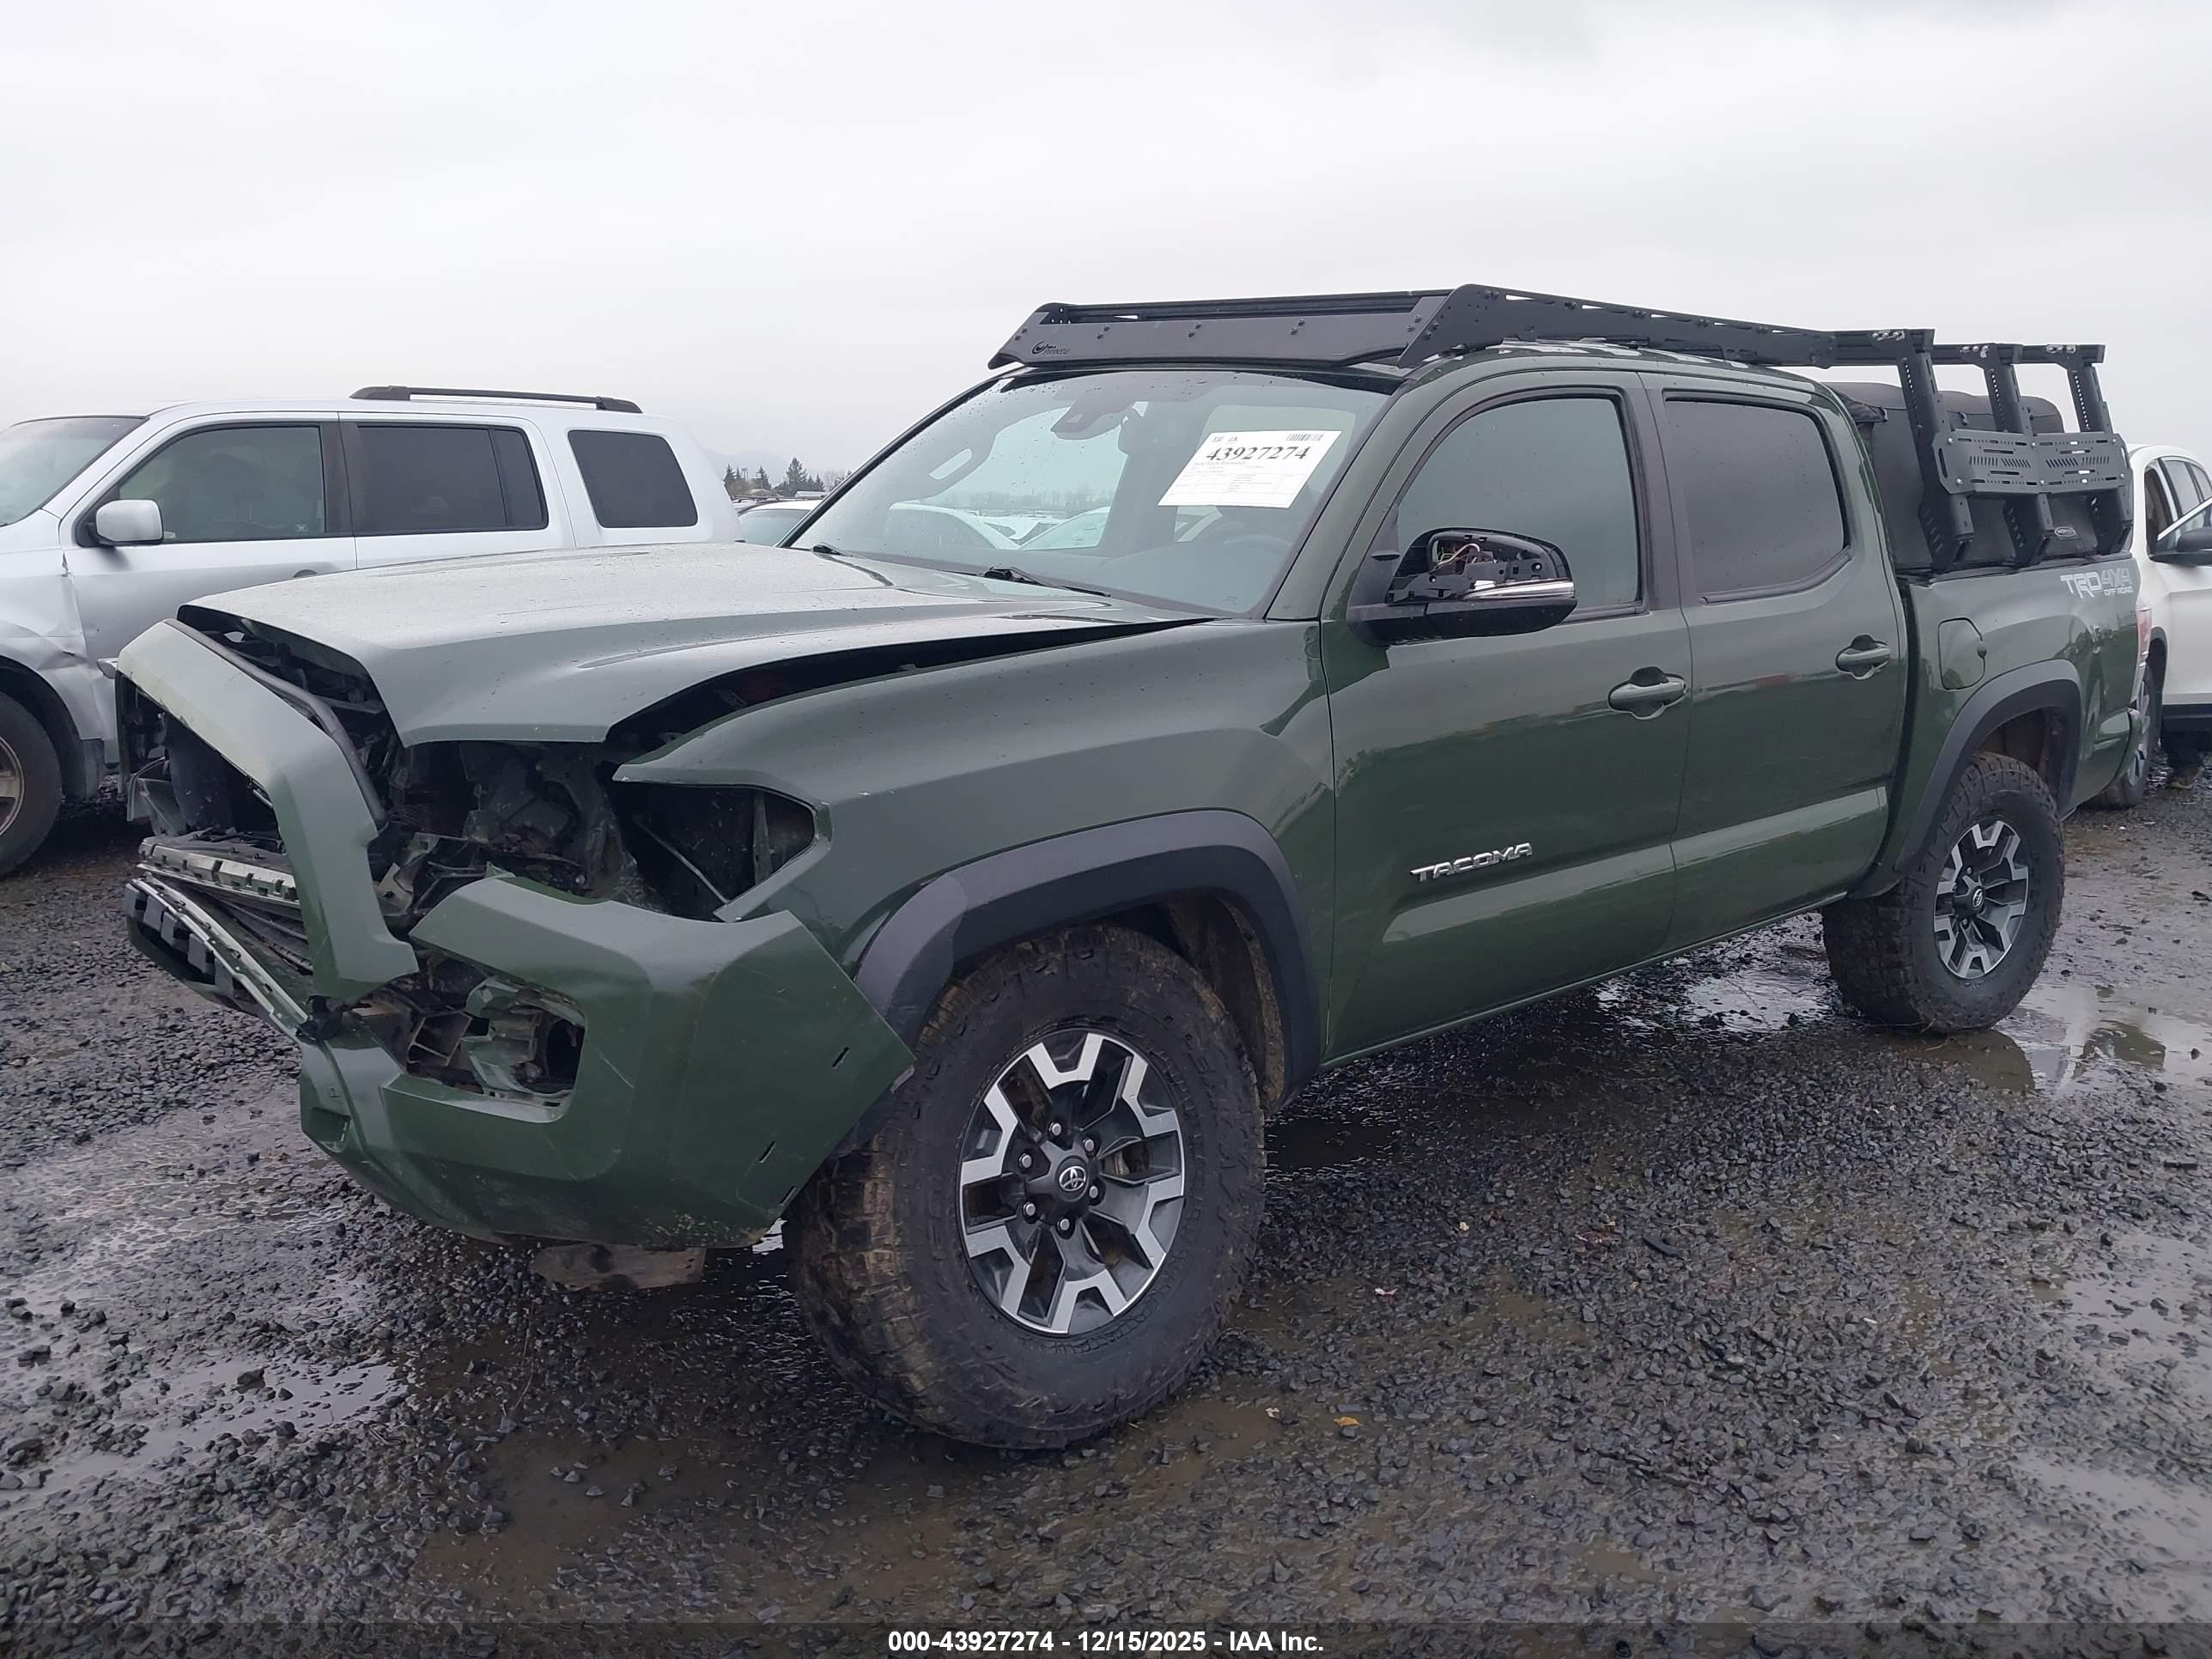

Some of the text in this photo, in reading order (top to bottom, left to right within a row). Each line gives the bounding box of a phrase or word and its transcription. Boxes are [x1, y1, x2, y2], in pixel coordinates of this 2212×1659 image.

[1206, 446, 1312, 461] 43927274
[2059, 571, 2102, 599] TRD
[1409, 842, 1533, 883] TACOMA
